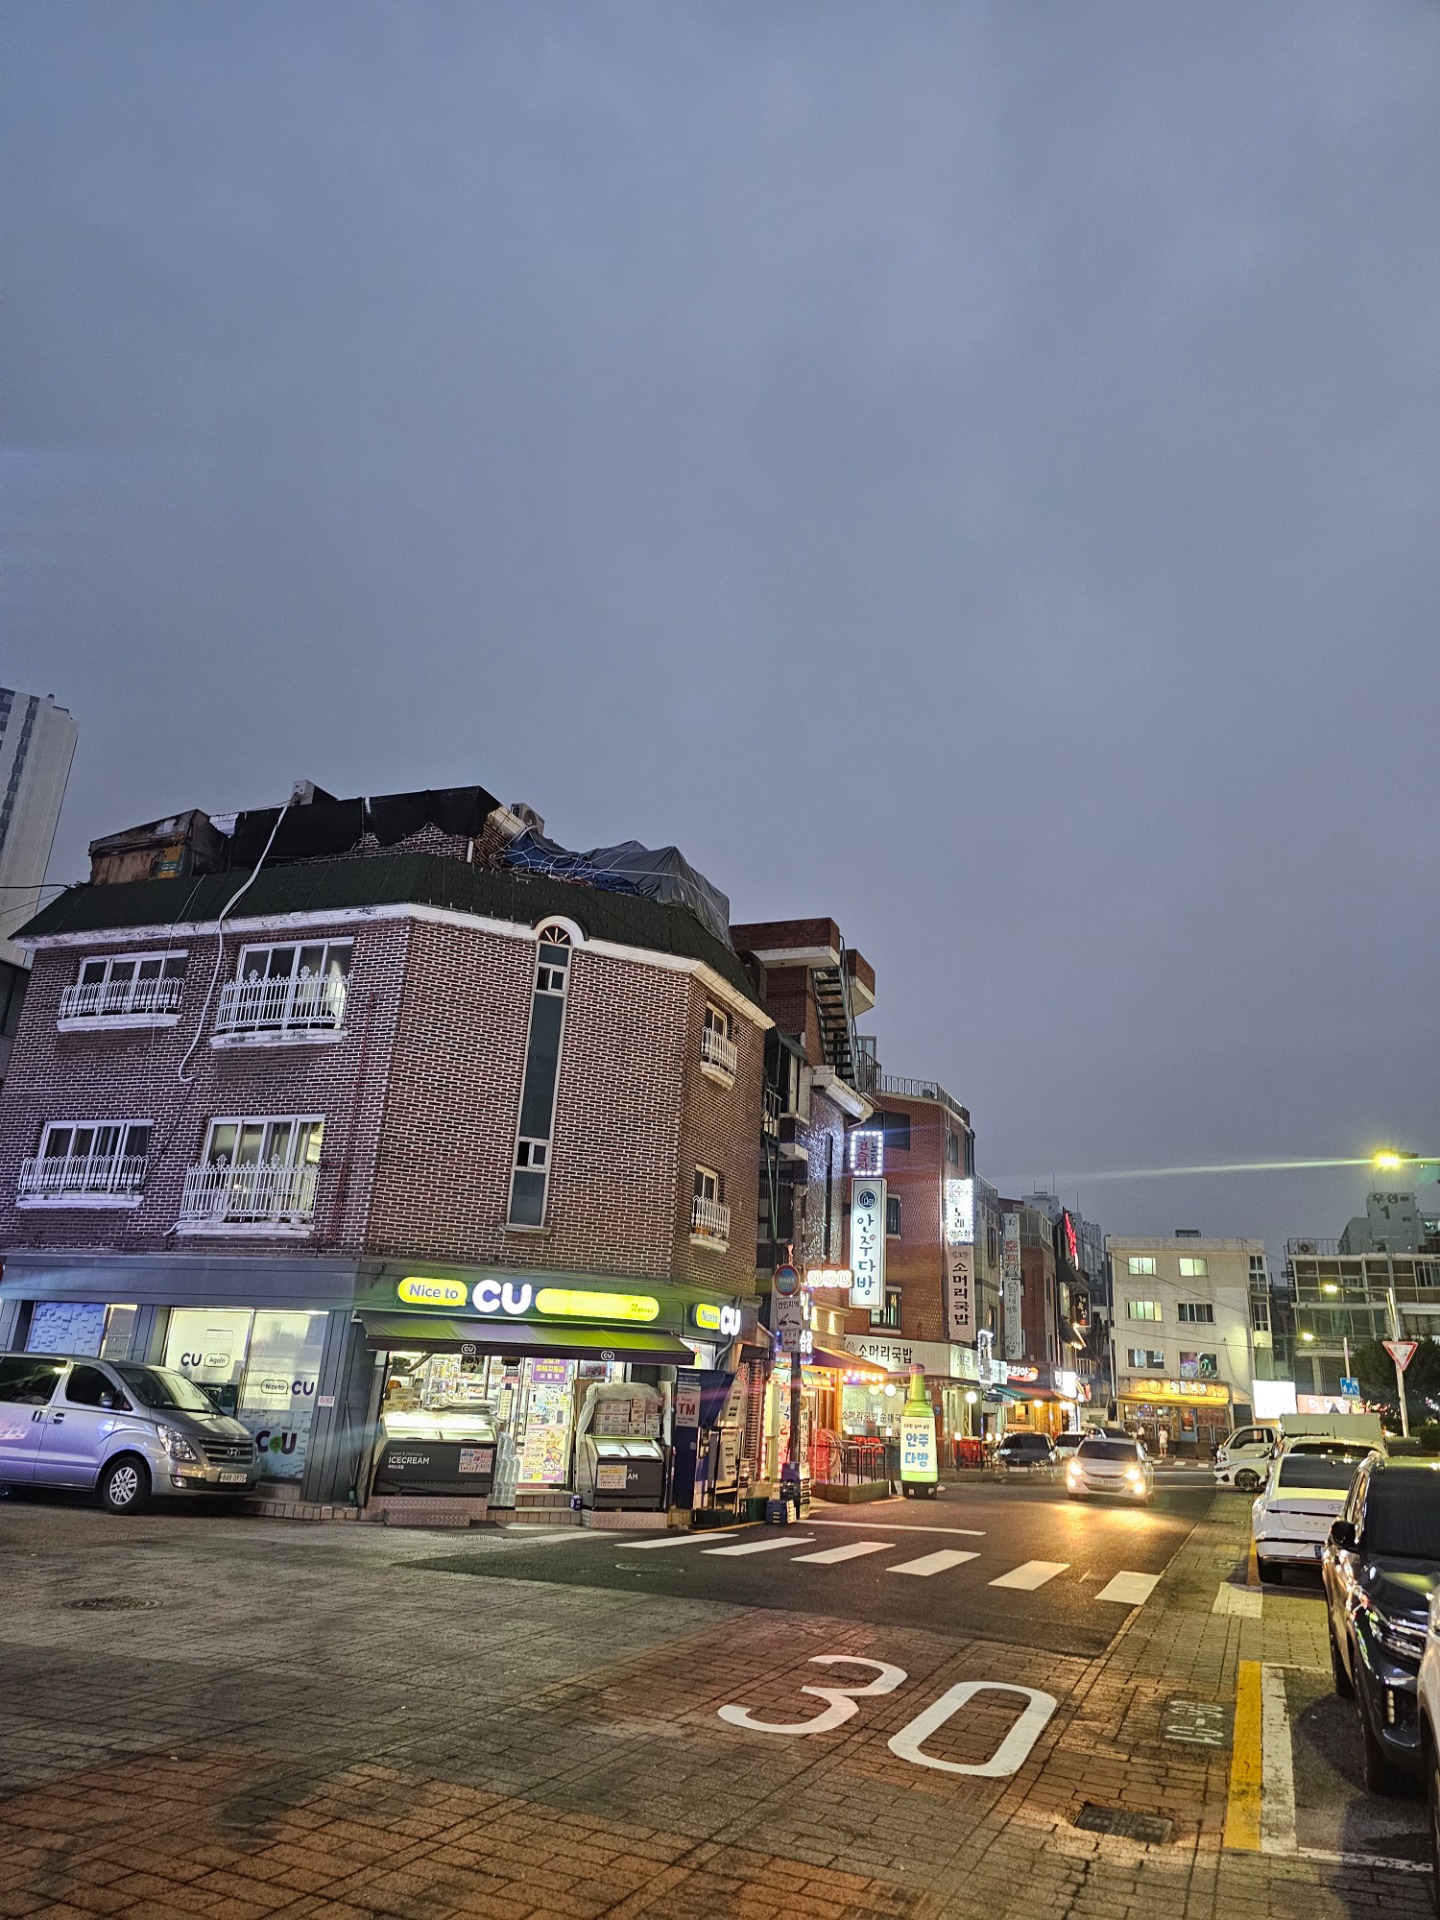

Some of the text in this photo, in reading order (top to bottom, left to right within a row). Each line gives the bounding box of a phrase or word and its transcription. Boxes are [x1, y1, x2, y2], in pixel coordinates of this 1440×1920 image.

[1380, 1206, 1390, 1219] 1
[857, 1214, 877, 1296] 안주다방
[409, 1283, 458, 1300] Nice to
[472, 1279, 533, 1315] CU
[952, 1262, 970, 1326] 소머리국밥
[777, 1300, 801, 1309] 견인지역
[701, 1309, 712, 1321] Nice
[721, 1305, 741, 1336] CU
[180, 1352, 226, 1367] CU Again
[858, 1345, 913, 1364] 소머리국밥
[291, 1380, 315, 1396] CU
[676, 1403, 696, 1416] TM
[841, 1410, 879, 1423] 소머리국밥
[255, 1430, 298, 1455] CU
[905, 1432, 929, 1448] 안주
[388, 1456, 430, 1465] ICECREAM
[905, 1452, 929, 1468] 다방
[717, 1654, 1058, 1778] 30
